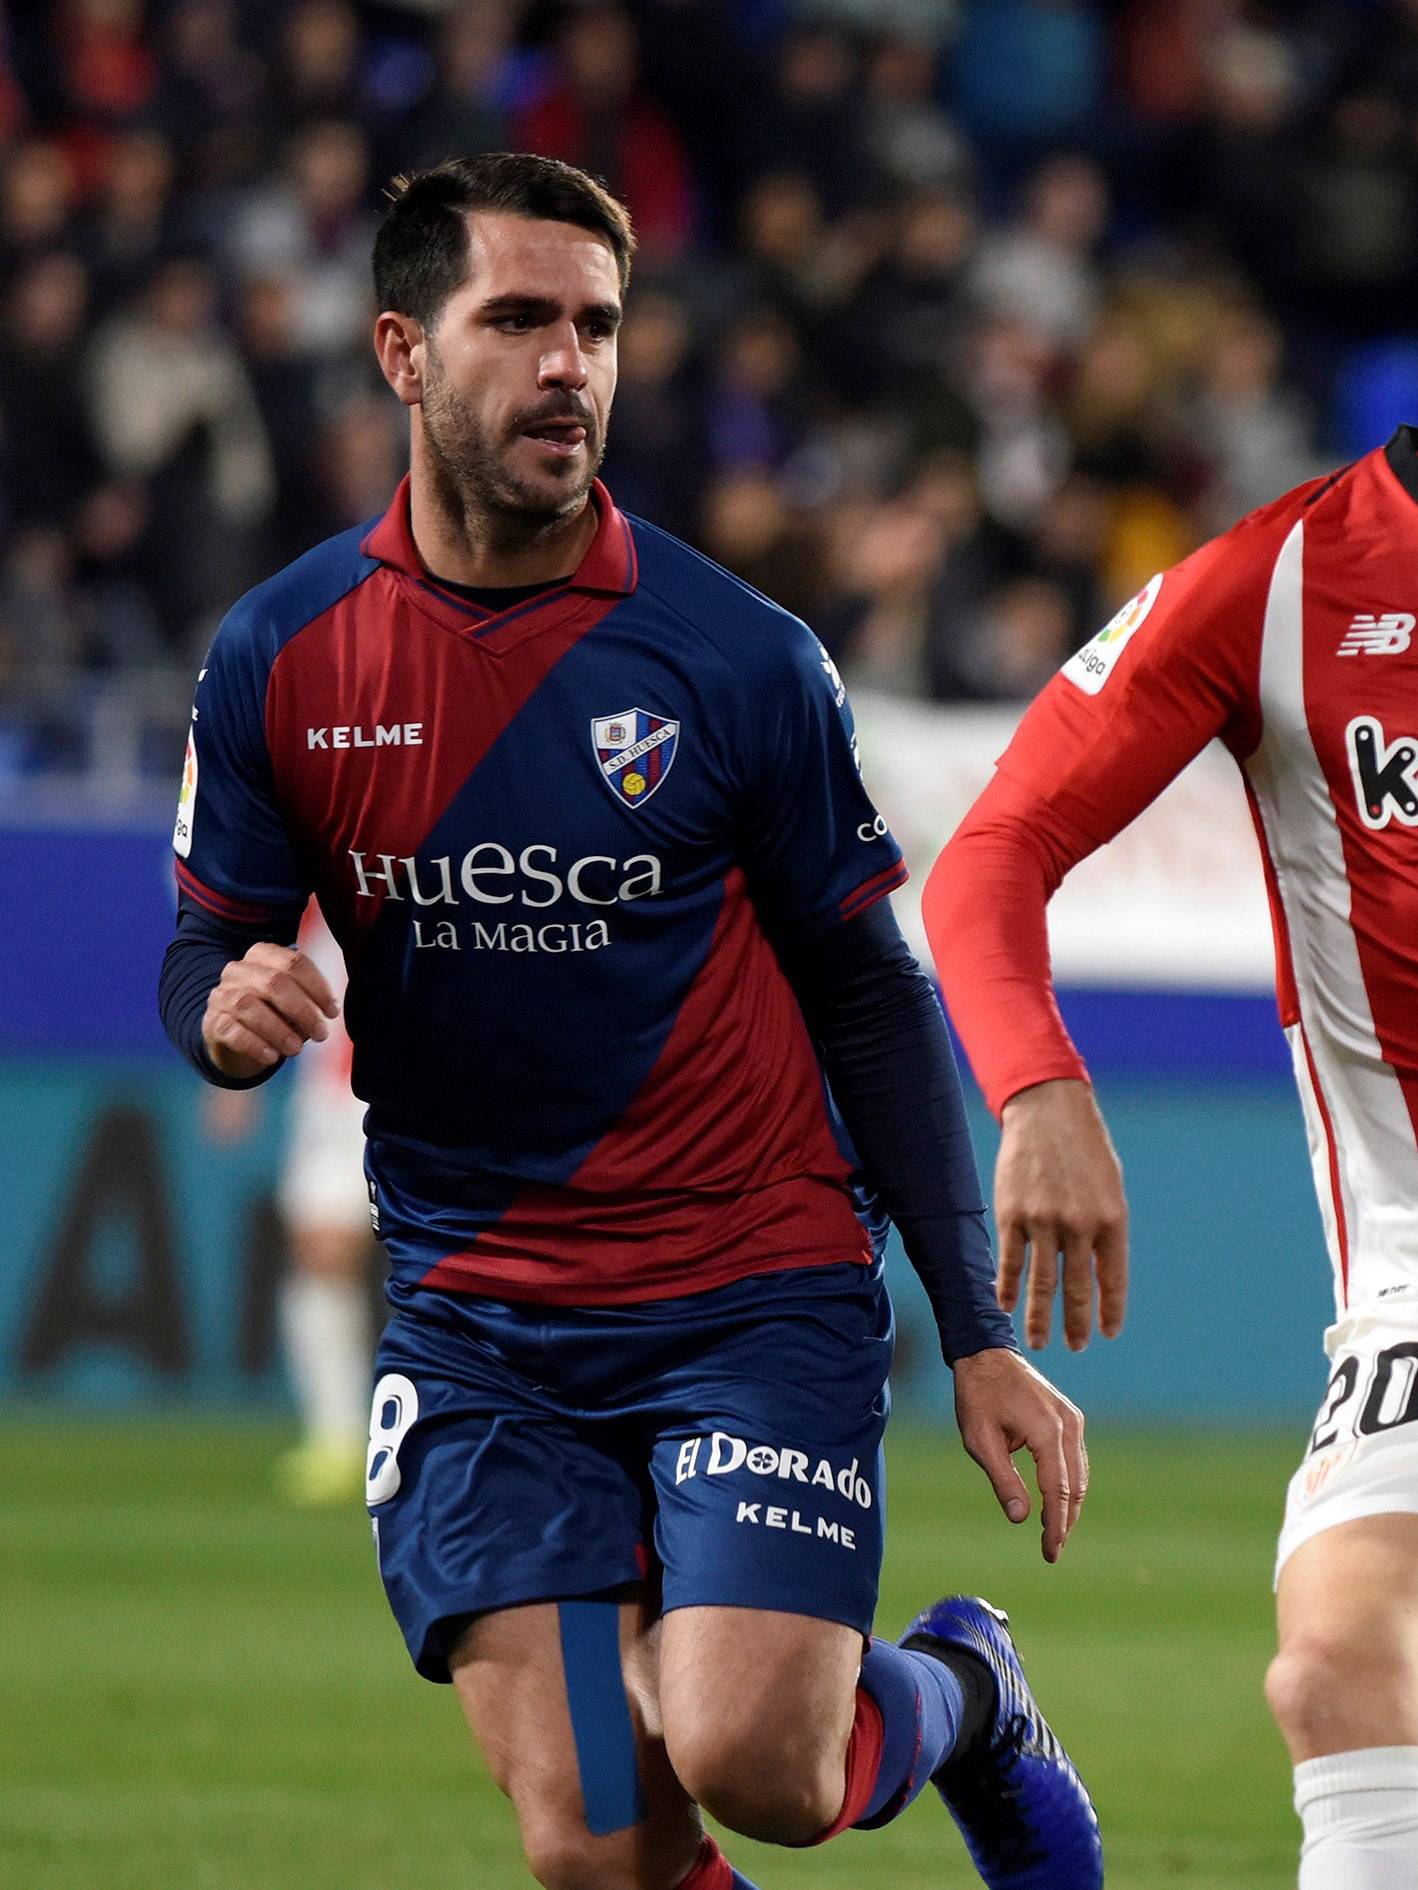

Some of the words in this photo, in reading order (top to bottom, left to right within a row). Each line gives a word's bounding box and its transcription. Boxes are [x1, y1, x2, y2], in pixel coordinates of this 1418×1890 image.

[307, 723, 424, 750] KELME
[629, 728, 671, 758] HUESCA
[366, 1373, 419, 1507] 8
[736, 1501, 856, 1550] KELME
